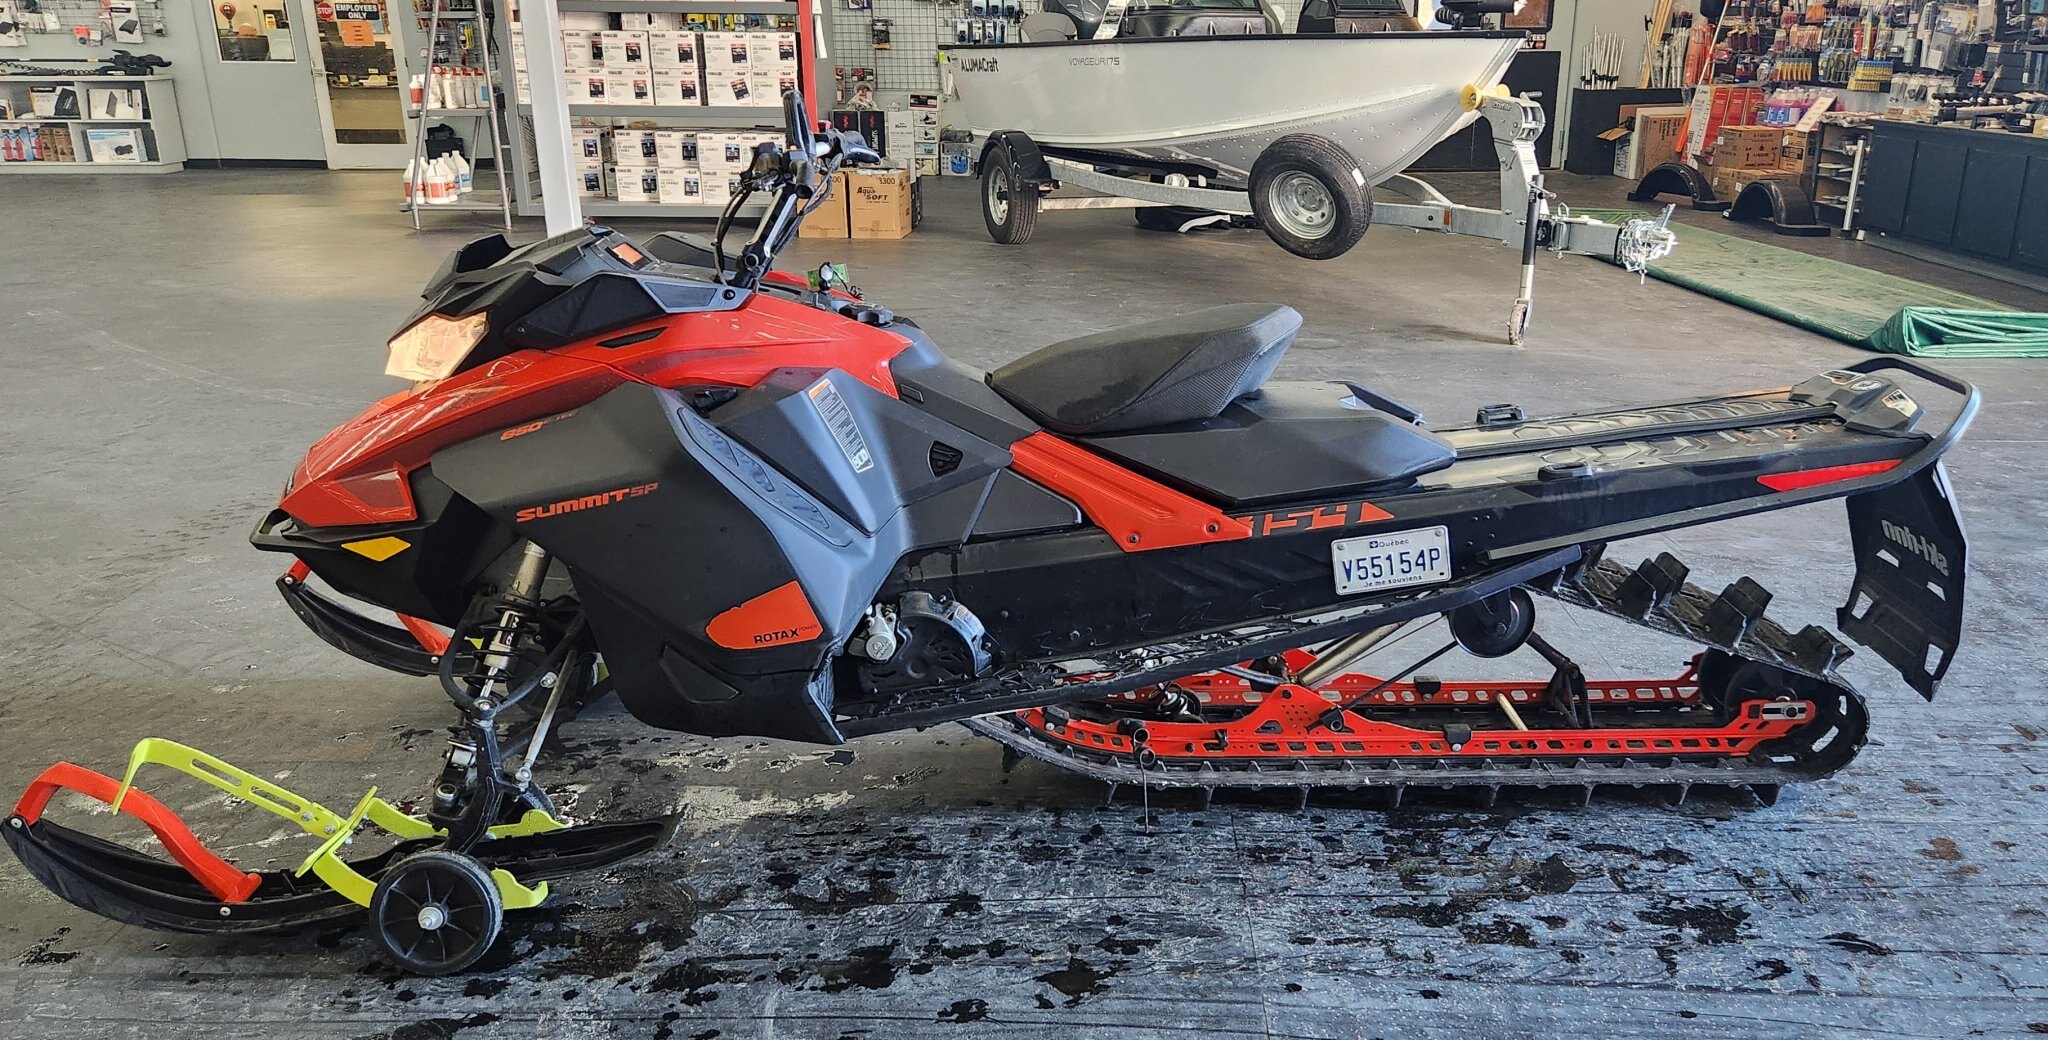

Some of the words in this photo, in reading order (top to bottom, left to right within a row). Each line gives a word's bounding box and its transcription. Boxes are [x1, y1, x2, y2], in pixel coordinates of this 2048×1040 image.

[961, 57, 999, 72] ALUMACraft
[857, 186, 875, 196] Aqua
[501, 421, 544, 440] 850
[516, 488, 630, 522] SUMMIT
[1380, 539, 1410, 548] Québec
[1342, 548, 1440, 582] V55154P
[1388, 575, 1422, 584] souviens
[754, 628, 799, 644] ROTAX
